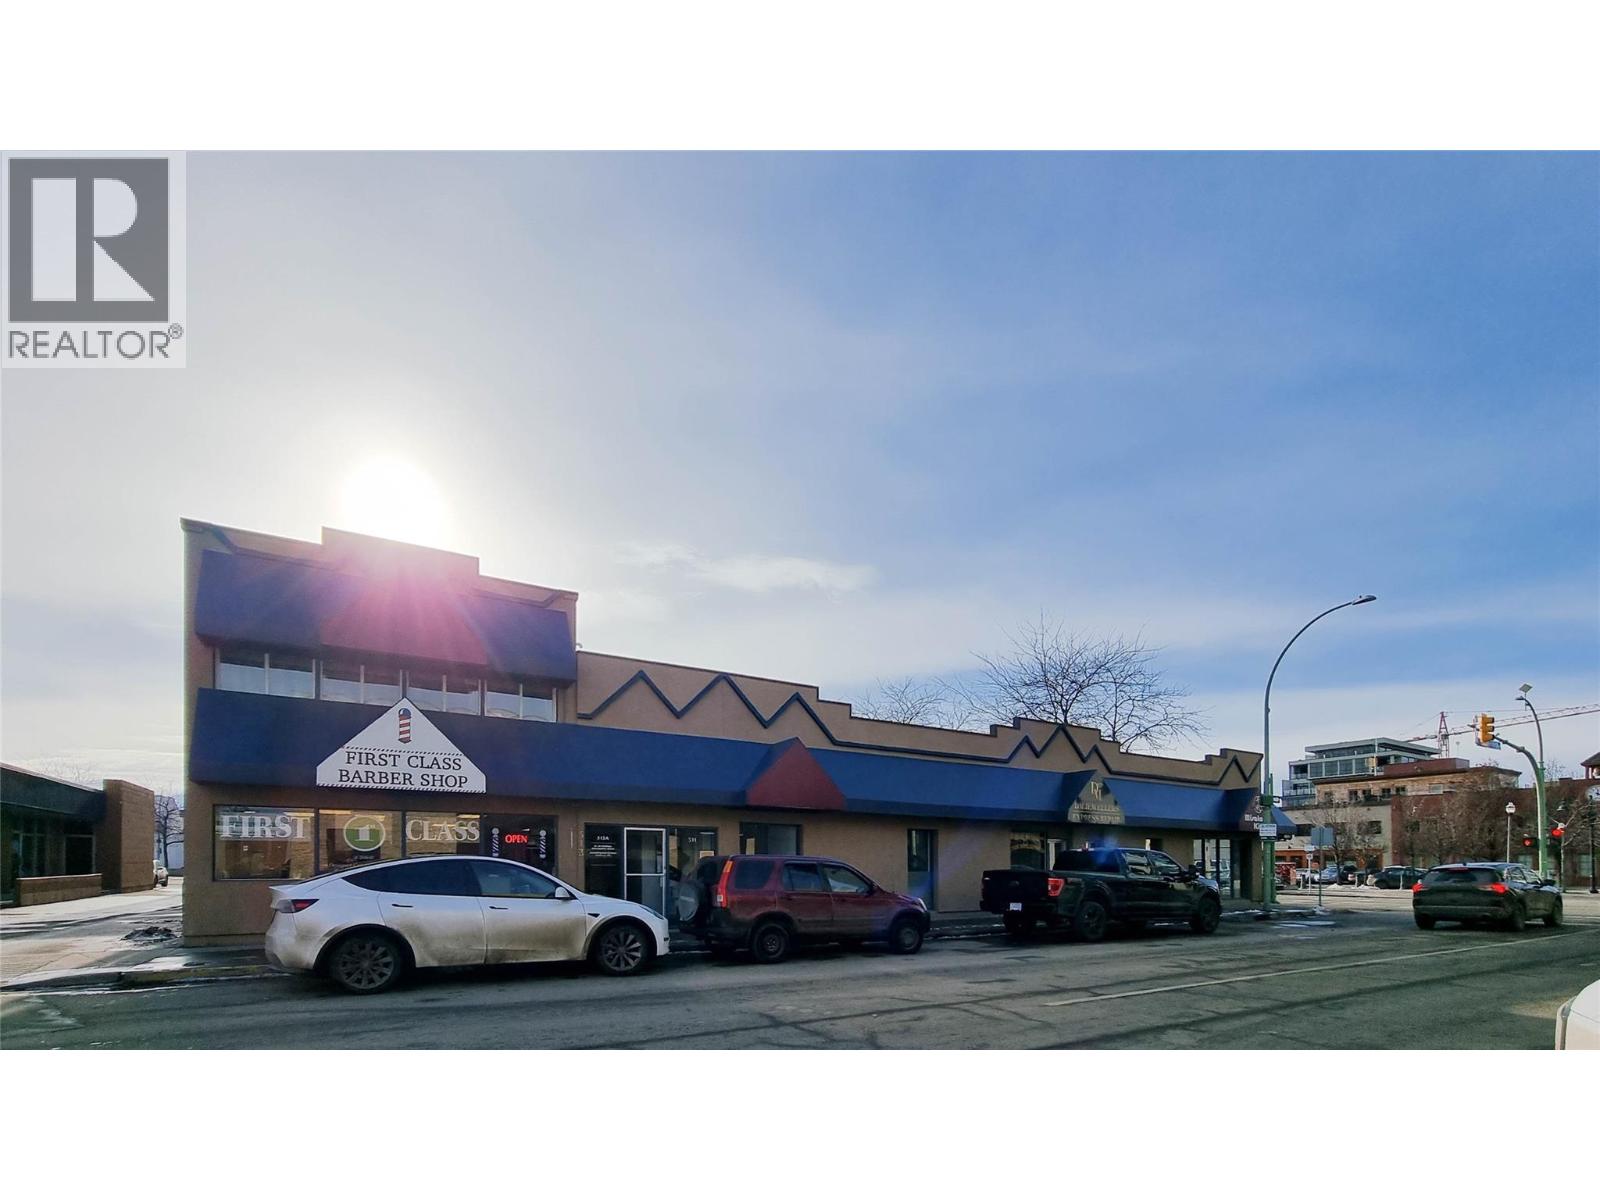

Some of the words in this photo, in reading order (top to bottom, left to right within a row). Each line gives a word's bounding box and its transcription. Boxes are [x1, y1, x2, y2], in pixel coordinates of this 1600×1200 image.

[345, 750, 400, 767] FIRST
[407, 755, 462, 771] CLASS
[338, 768, 414, 786] BARBER
[420, 773, 468, 788] SHOP
[220, 815, 312, 839] FIRST
[405, 819, 480, 841] CLASS
[504, 834, 528, 844] OPEN
